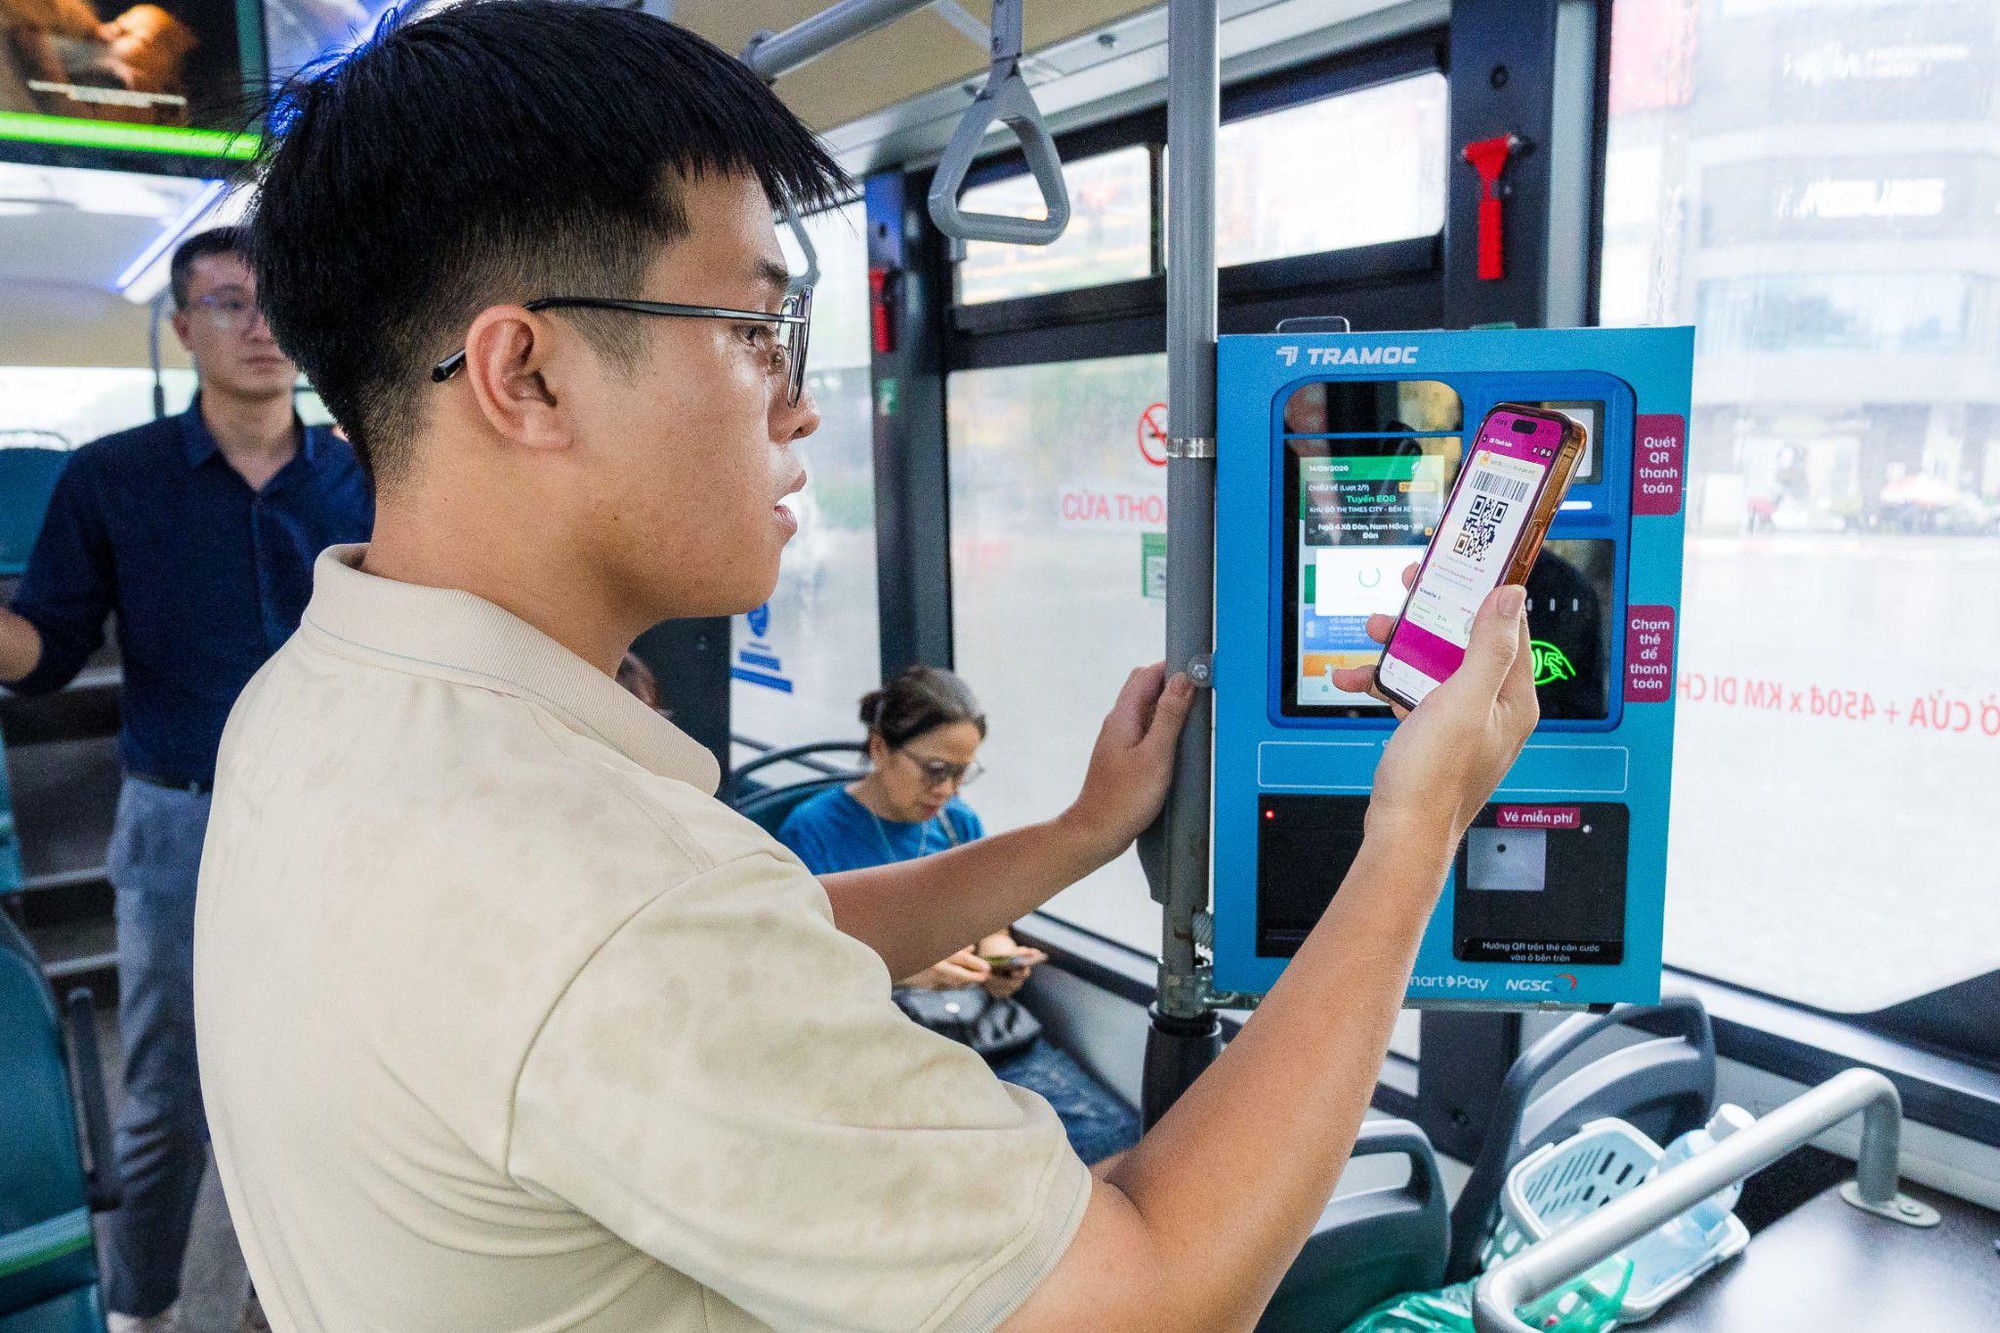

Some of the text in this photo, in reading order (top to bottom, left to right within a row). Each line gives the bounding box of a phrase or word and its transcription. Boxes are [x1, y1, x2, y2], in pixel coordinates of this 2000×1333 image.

[1307, 347, 1419, 365] TRAMOC
[1643, 436, 1677, 449] Quét
[1649, 452, 1669, 464] QR
[1639, 467, 1678, 478] thanh
[1642, 482, 1673, 494] toán
[1346, 493, 1375, 505] Tuyến
[1061, 488, 1168, 524] CỬA THO
[1631, 619, 1670, 632] Chạm
[1639, 633, 1661, 645] thẻ
[1641, 646, 1658, 660] để
[1630, 663, 1667, 674] thanh
[1633, 678, 1663, 689] toán
[1503, 810, 1573, 825] Vé miễn phí
[1482, 941, 1510, 952] Hướng
[1511, 942, 1526, 951] QR
[1527, 942, 1544, 950] trên
[1579, 944, 1600, 952] cước
[1535, 954, 1551, 962] bên
[1553, 954, 1570, 962] trên
[1457, 975, 1490, 991] Pay
[1505, 979, 1553, 992] NGSC
